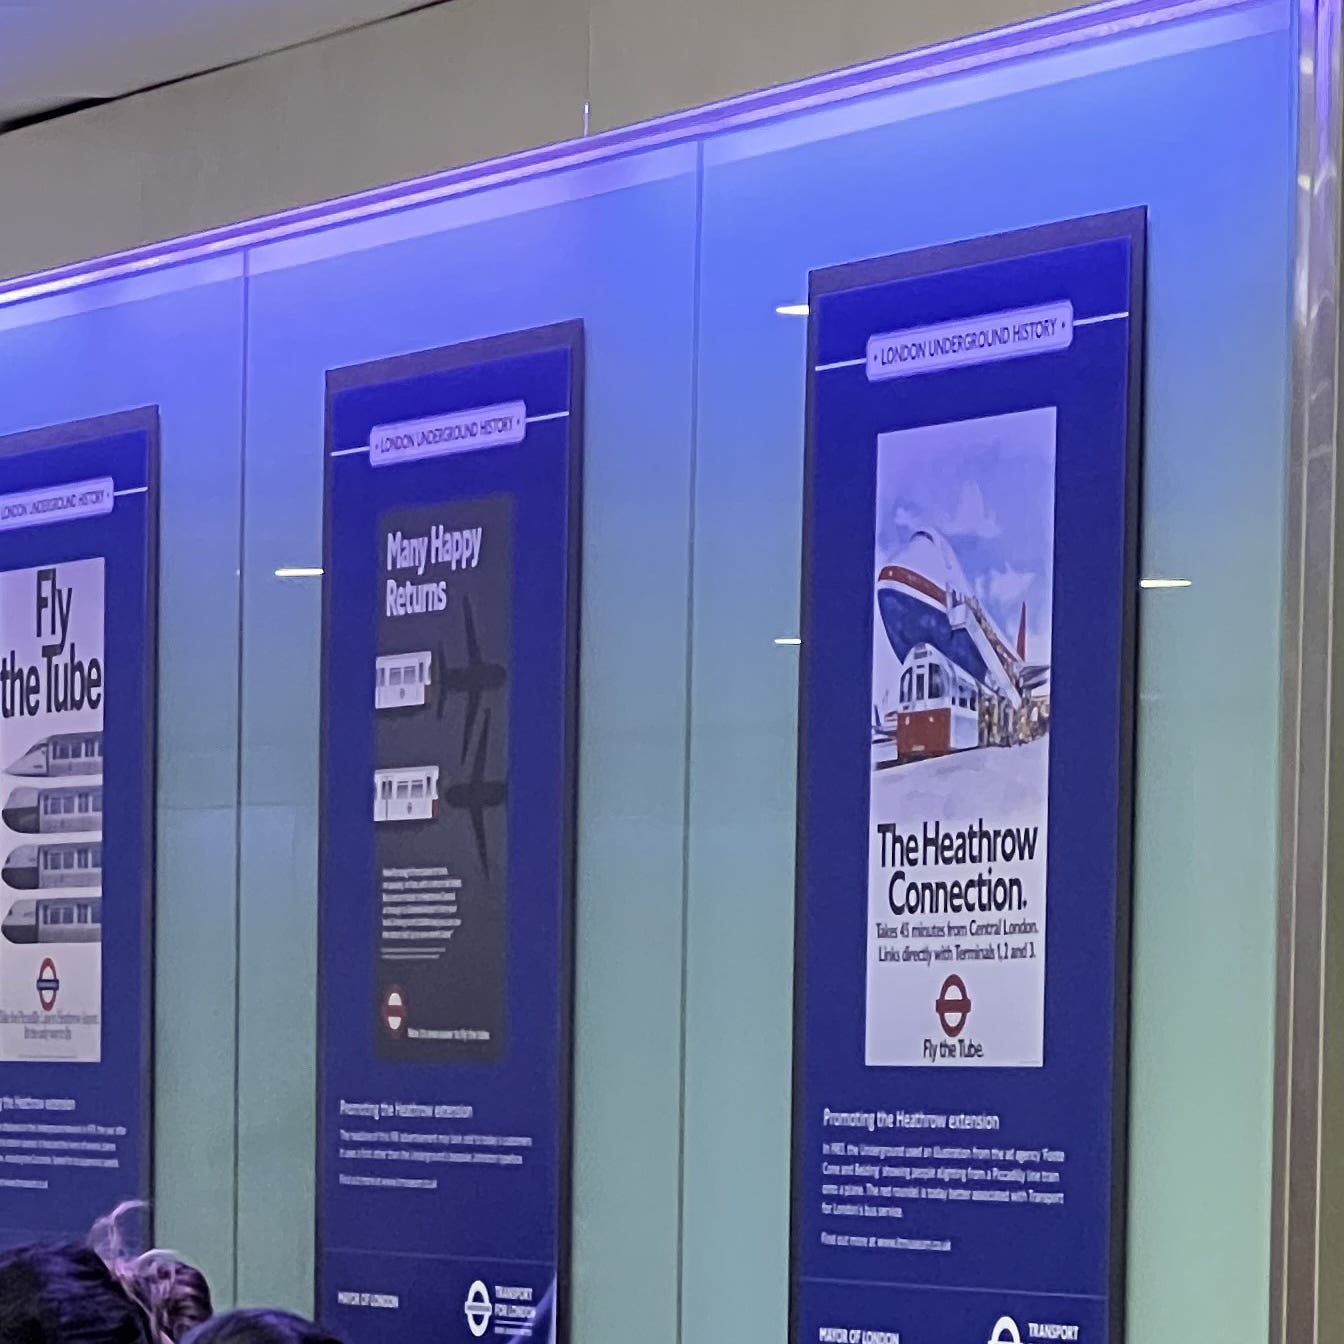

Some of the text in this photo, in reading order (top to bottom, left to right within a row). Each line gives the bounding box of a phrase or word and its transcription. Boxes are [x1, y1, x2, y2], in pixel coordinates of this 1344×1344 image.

[880, 317, 1057, 366] LONDON UNDERGROUND HISTORY
[380, 433, 414, 454] LONDON
[416, 421, 478, 447] UNDERGROUND
[387, 524, 482, 575] Many Happy
[36, 568, 73, 656] Fly
[386, 579, 447, 617] Returns
[0, 642, 102, 718] the Tube
[877, 817, 1039, 868] The Heathrow
[888, 866, 1028, 916] Connection.
[923, 1038, 938, 1063] Fly
[939, 1038, 957, 1058] the
[823, 1107, 1000, 1132] Promoting the Heathrow extension
[819, 1327, 848, 1344] MAYOR
[849, 1329, 861, 1344] OF
[1028, 1322, 1079, 1341] TRANSPORT
